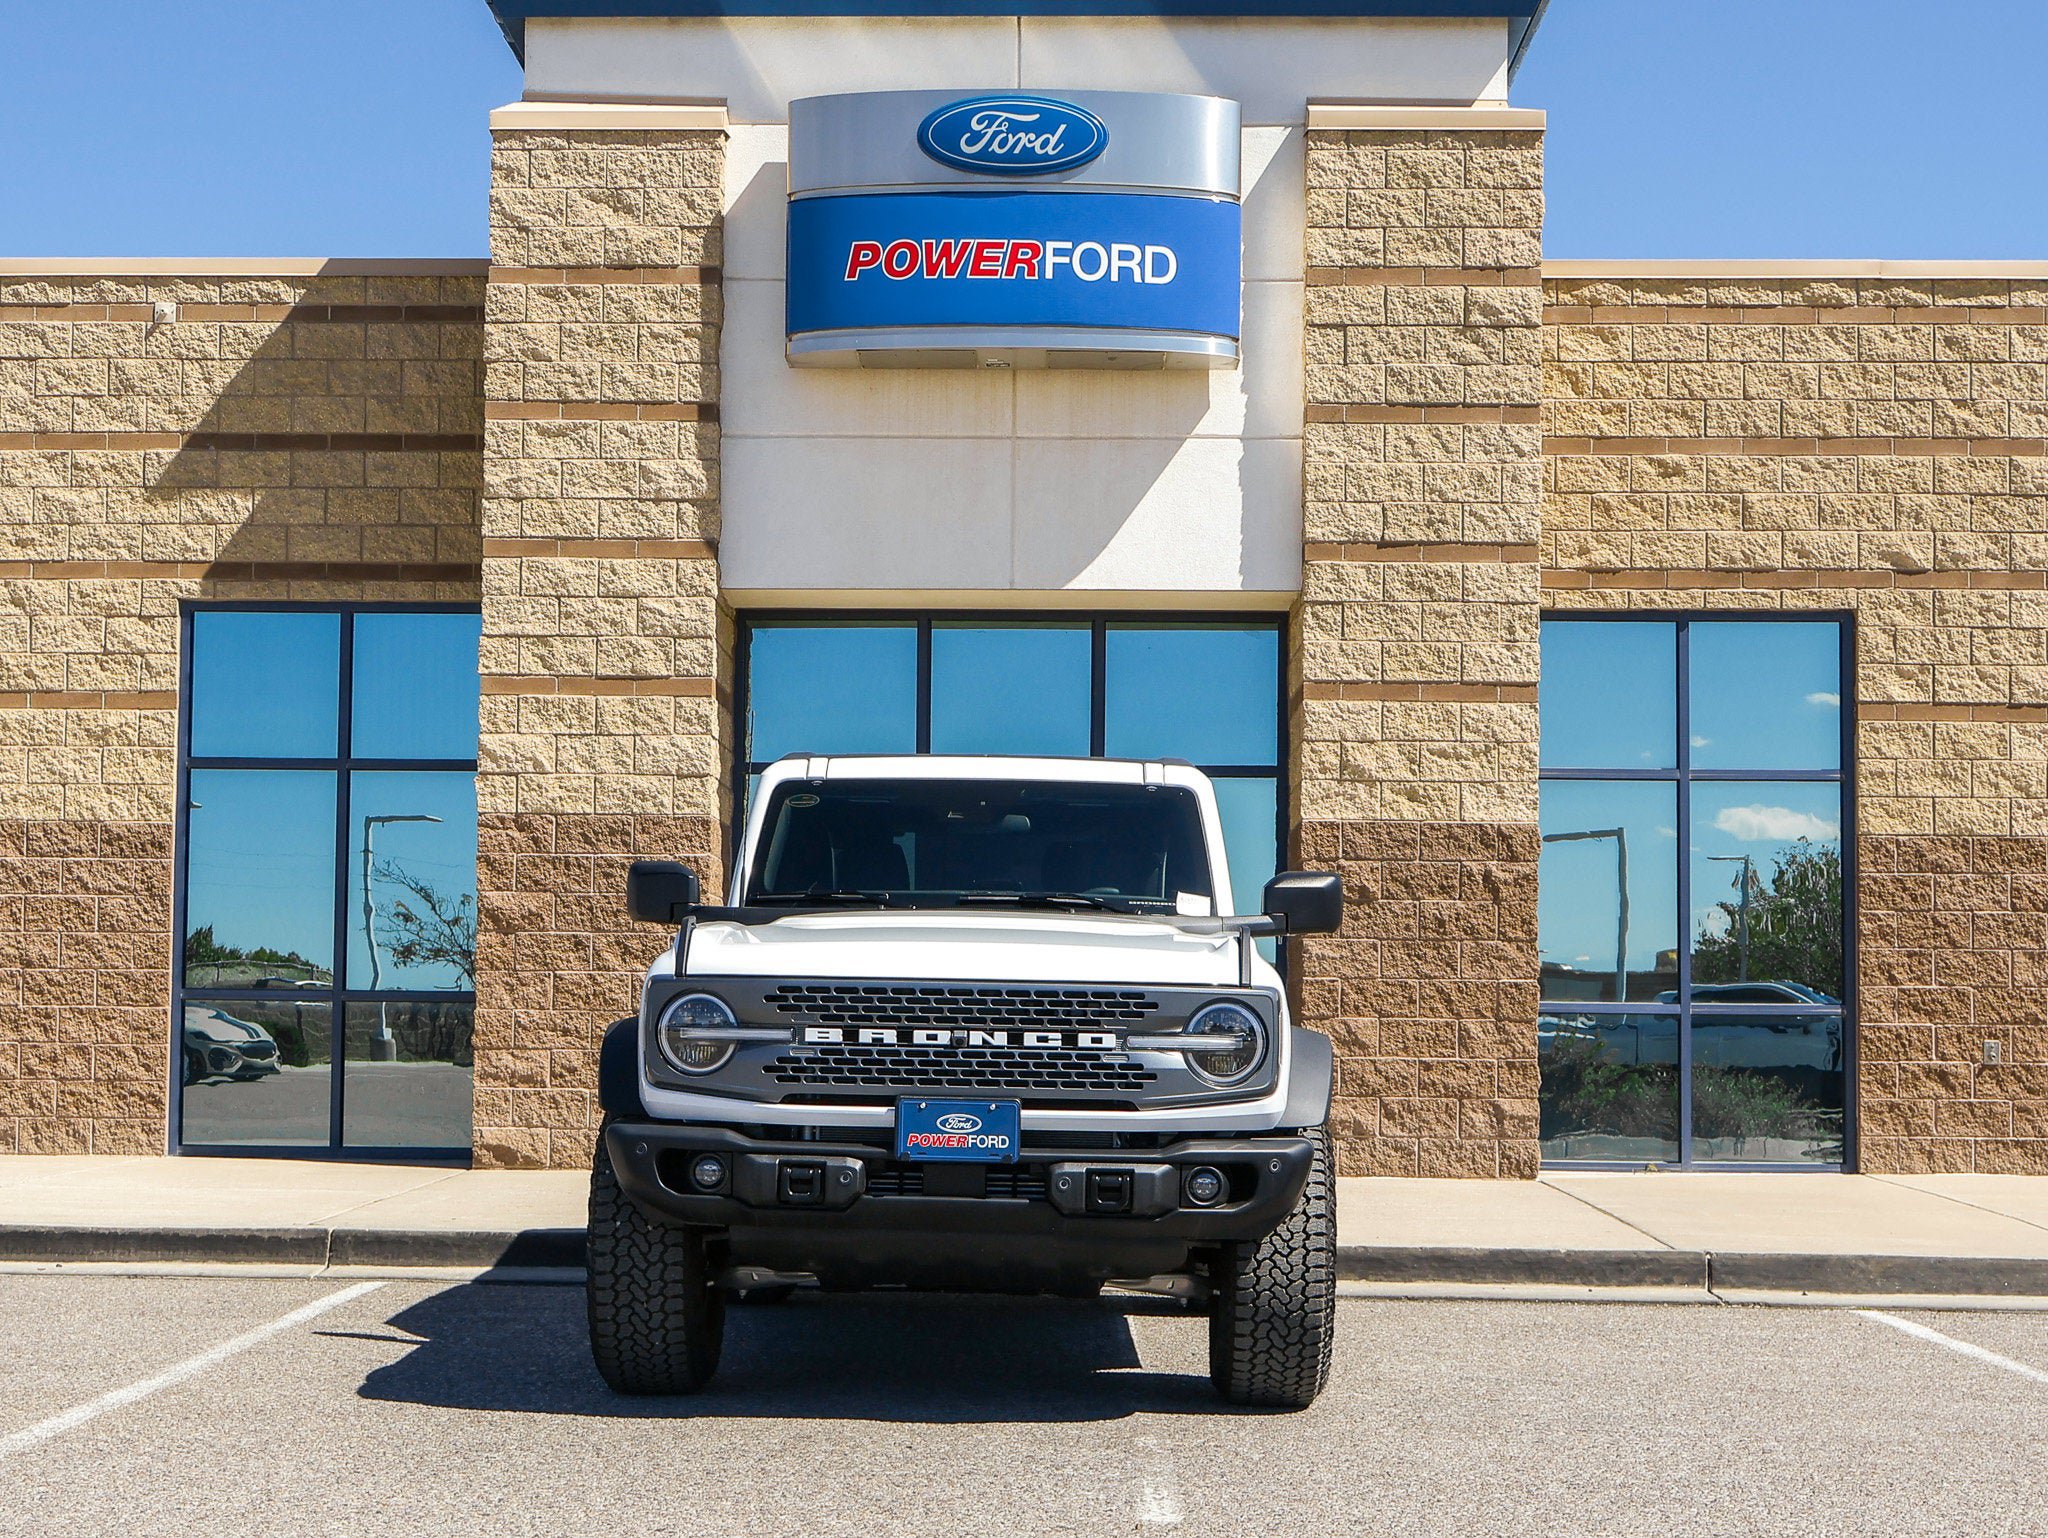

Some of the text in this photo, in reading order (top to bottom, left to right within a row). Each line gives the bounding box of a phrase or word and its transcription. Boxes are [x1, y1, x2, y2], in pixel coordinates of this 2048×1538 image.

[960, 110, 1067, 156] Ford
[804, 1027, 1117, 1049] BRONCO
[945, 1117, 973, 1129] Ford
